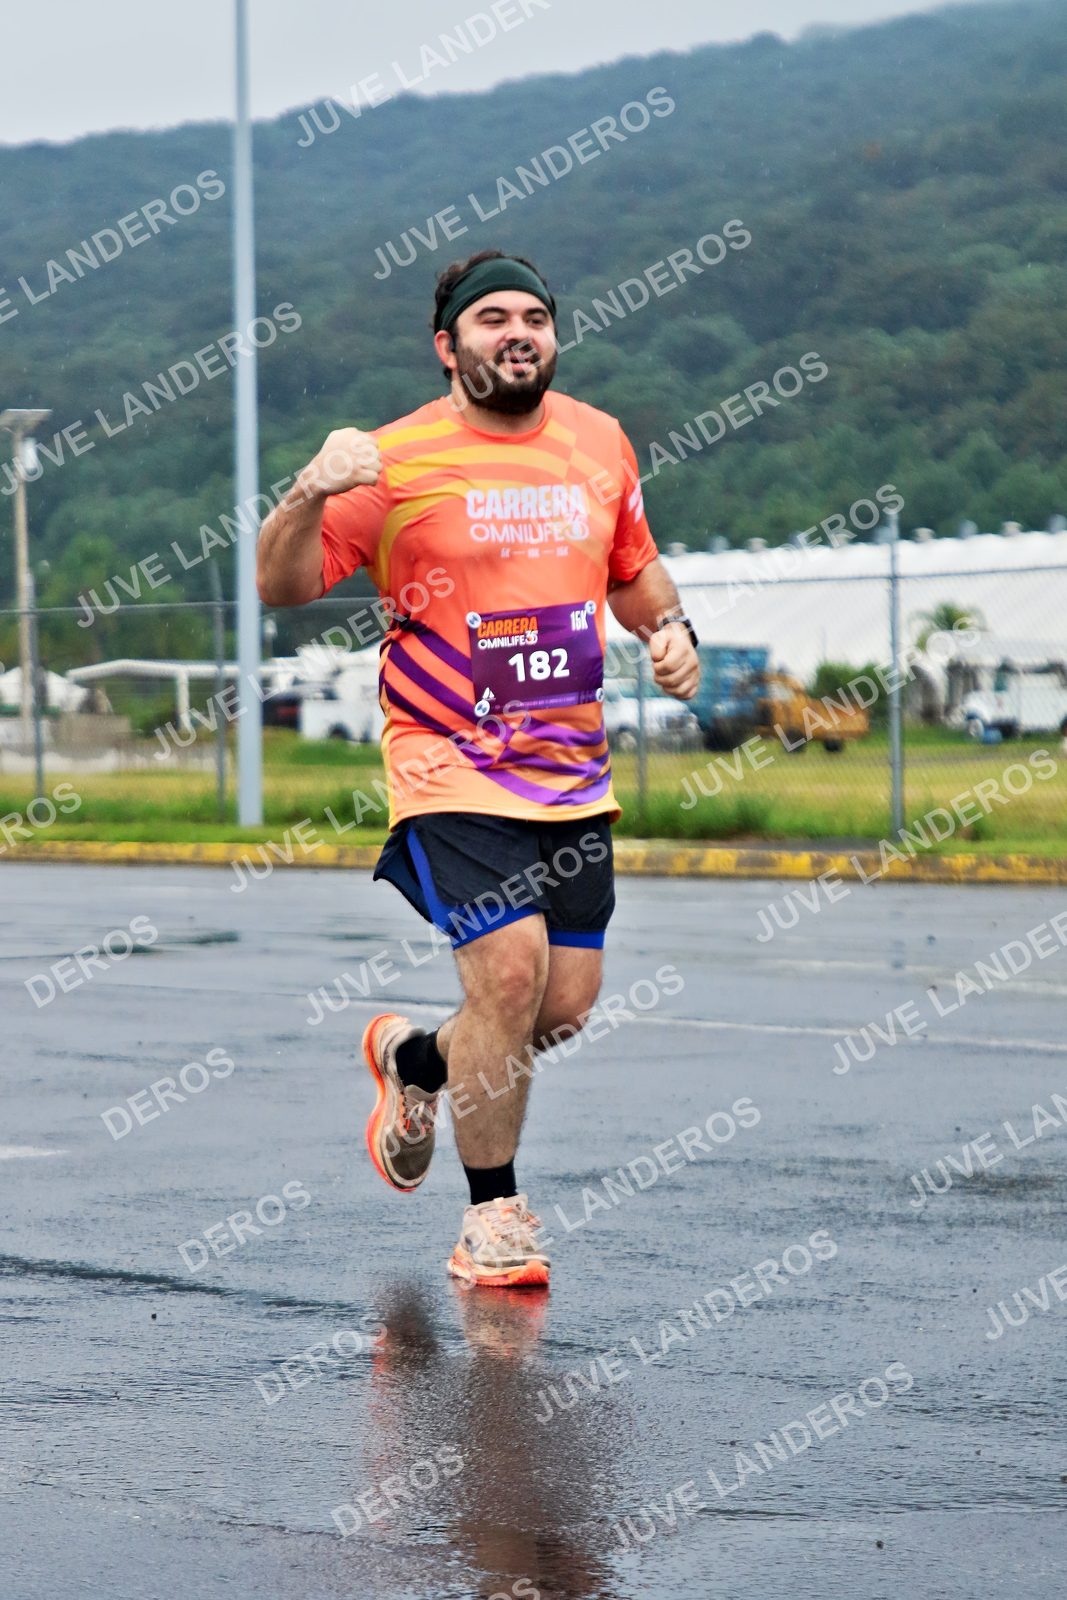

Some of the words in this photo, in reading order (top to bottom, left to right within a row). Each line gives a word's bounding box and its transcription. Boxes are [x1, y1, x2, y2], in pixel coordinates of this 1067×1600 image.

[466, 484, 587, 519] CARRERA
[470, 521, 565, 544] OMNILIFE
[477, 616, 538, 638] CARRERA
[478, 634, 525, 650] OMNILIFE
[508, 648, 570, 682] 182
